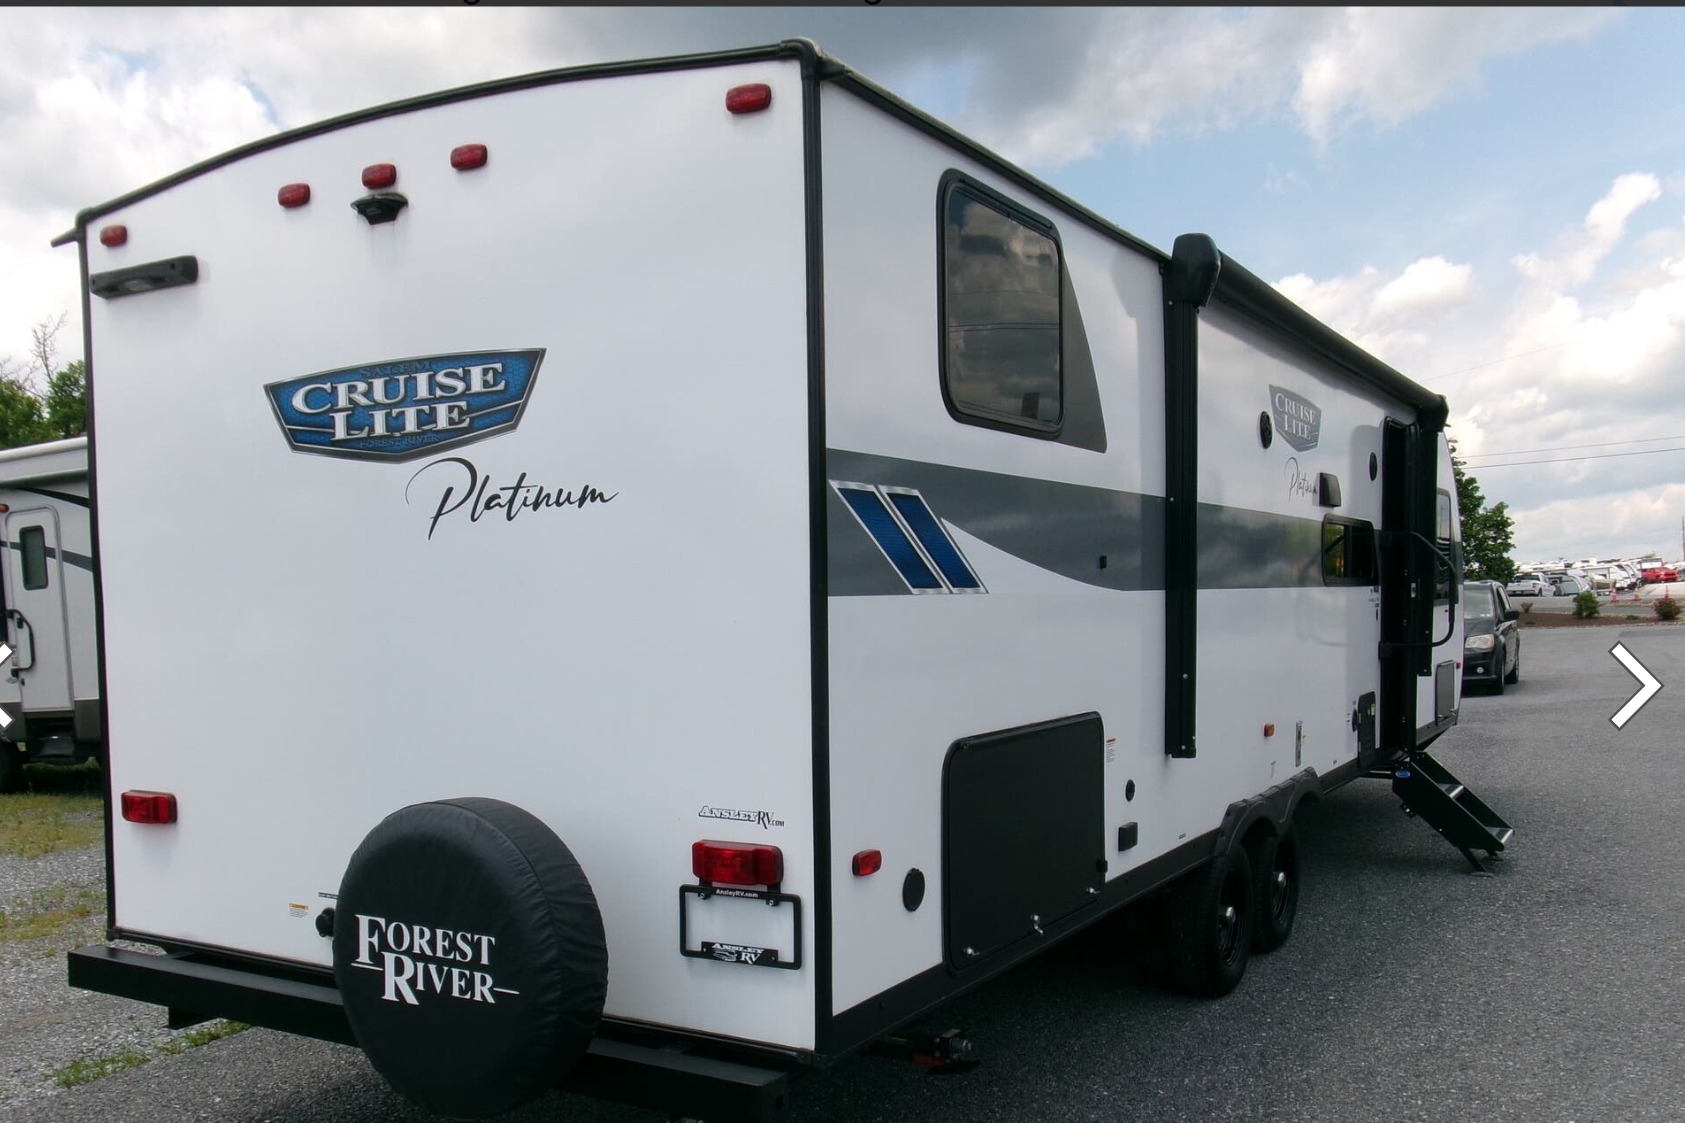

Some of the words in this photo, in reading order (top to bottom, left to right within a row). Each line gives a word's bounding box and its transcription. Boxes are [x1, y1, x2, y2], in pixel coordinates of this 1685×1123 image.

[291, 362, 506, 414] CRUISE
[329, 400, 471, 442] LITE
[1275, 392, 1317, 425] CRUISE
[360, 438, 401, 449] FOREST
[405, 434, 439, 446] RIVER
[1284, 413, 1311, 440] LITE
[405, 456, 620, 541] Platinum
[715, 888, 759, 898] AnsleyRV.com
[354, 913, 496, 965] FOREST
[711, 942, 765, 955] ANSLEY
[740, 952, 761, 965] RV
[381, 950, 496, 1006] RIVER
